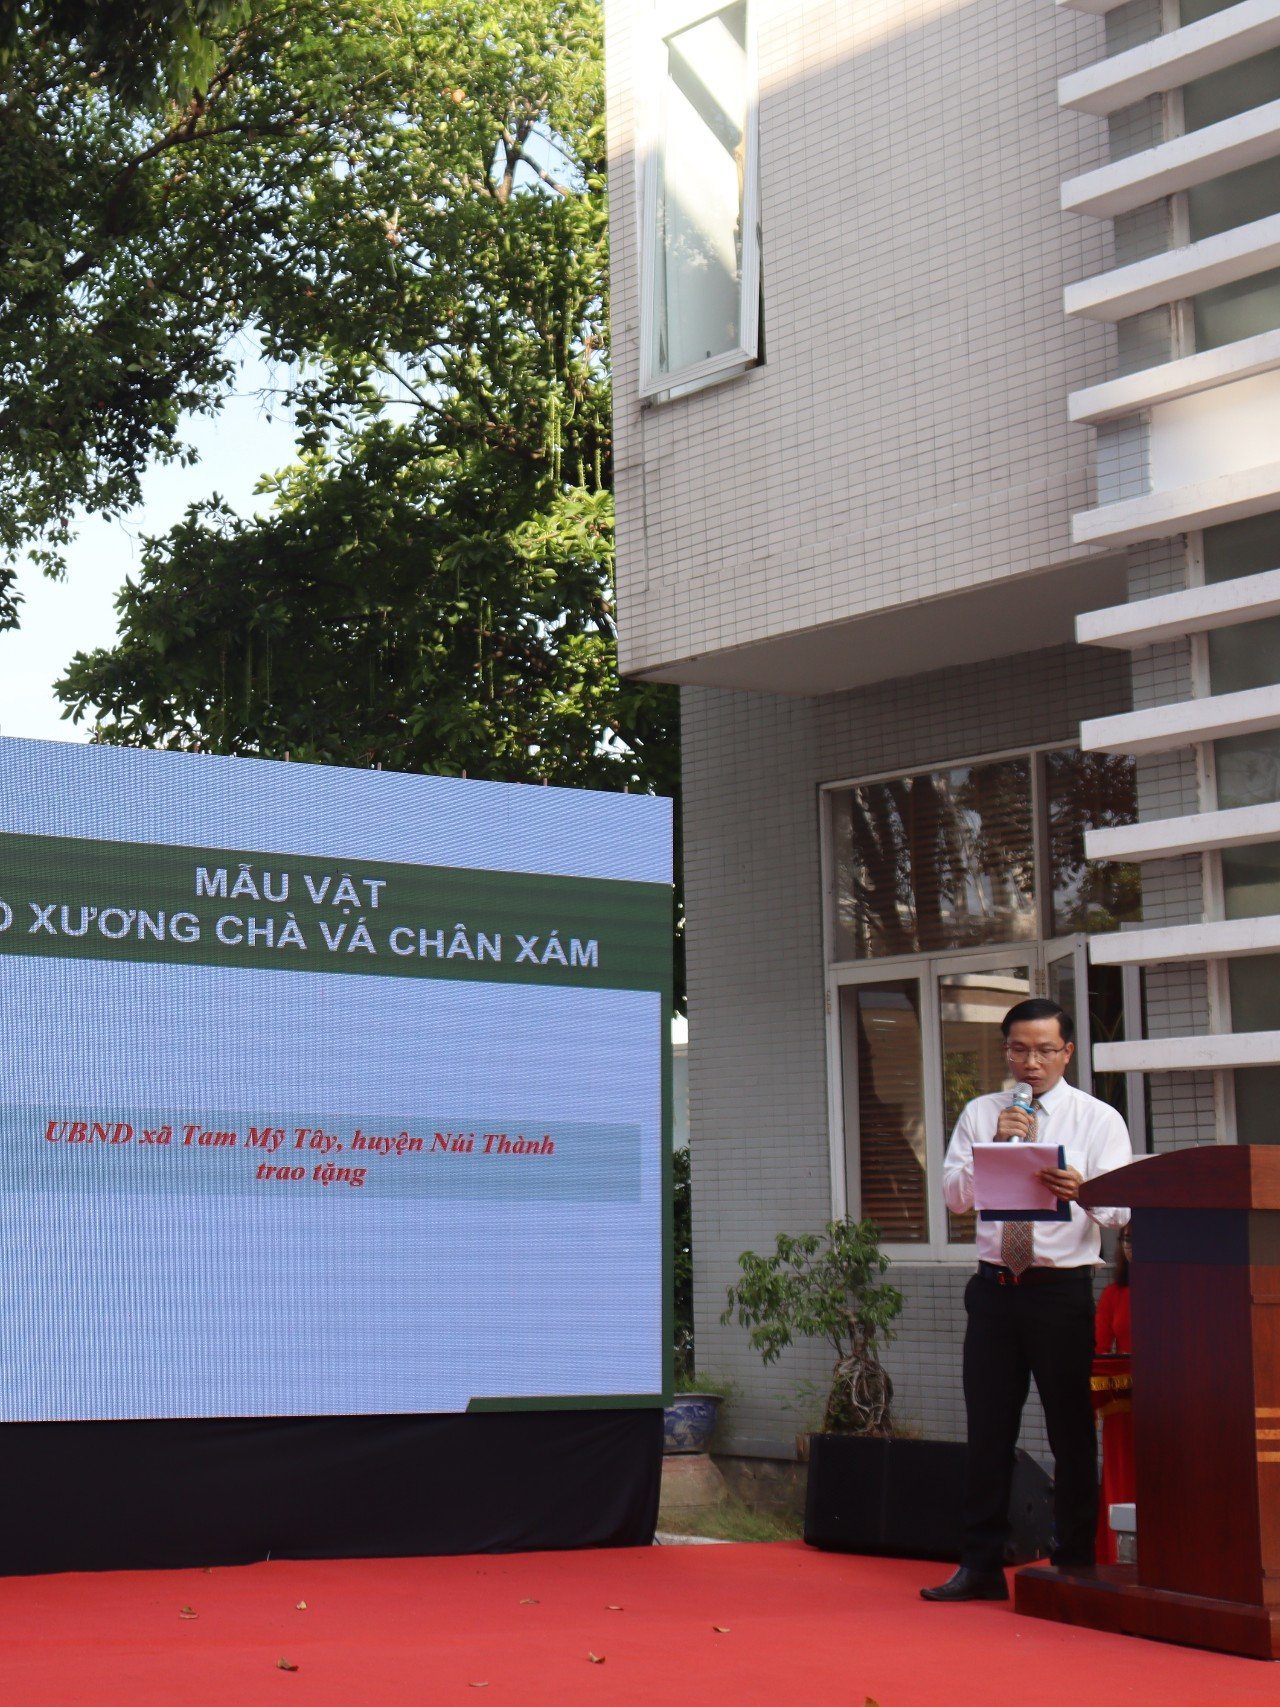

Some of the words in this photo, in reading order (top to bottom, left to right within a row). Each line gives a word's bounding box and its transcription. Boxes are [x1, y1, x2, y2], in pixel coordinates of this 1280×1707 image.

[195, 863, 289, 902] MẪU
[304, 872, 387, 915] VẬT
[28, 902, 200, 943] XƯƠNG
[215, 911, 308, 950] CHÀ
[318, 916, 377, 955] VÁ
[389, 923, 501, 962] CHÂN
[515, 929, 599, 968] XÁM
[45, 1120, 134, 1145] UBND
[139, 1125, 173, 1145] xã
[182, 1125, 237, 1148] Tam
[244, 1127, 286, 1153] Mỹ
[294, 1128, 344, 1154] Tây,
[351, 1129, 424, 1156] huyện
[431, 1132, 476, 1153] Núi
[483, 1134, 556, 1155] Thành
[256, 1161, 306, 1182] trao
[312, 1162, 368, 1187] tặng
